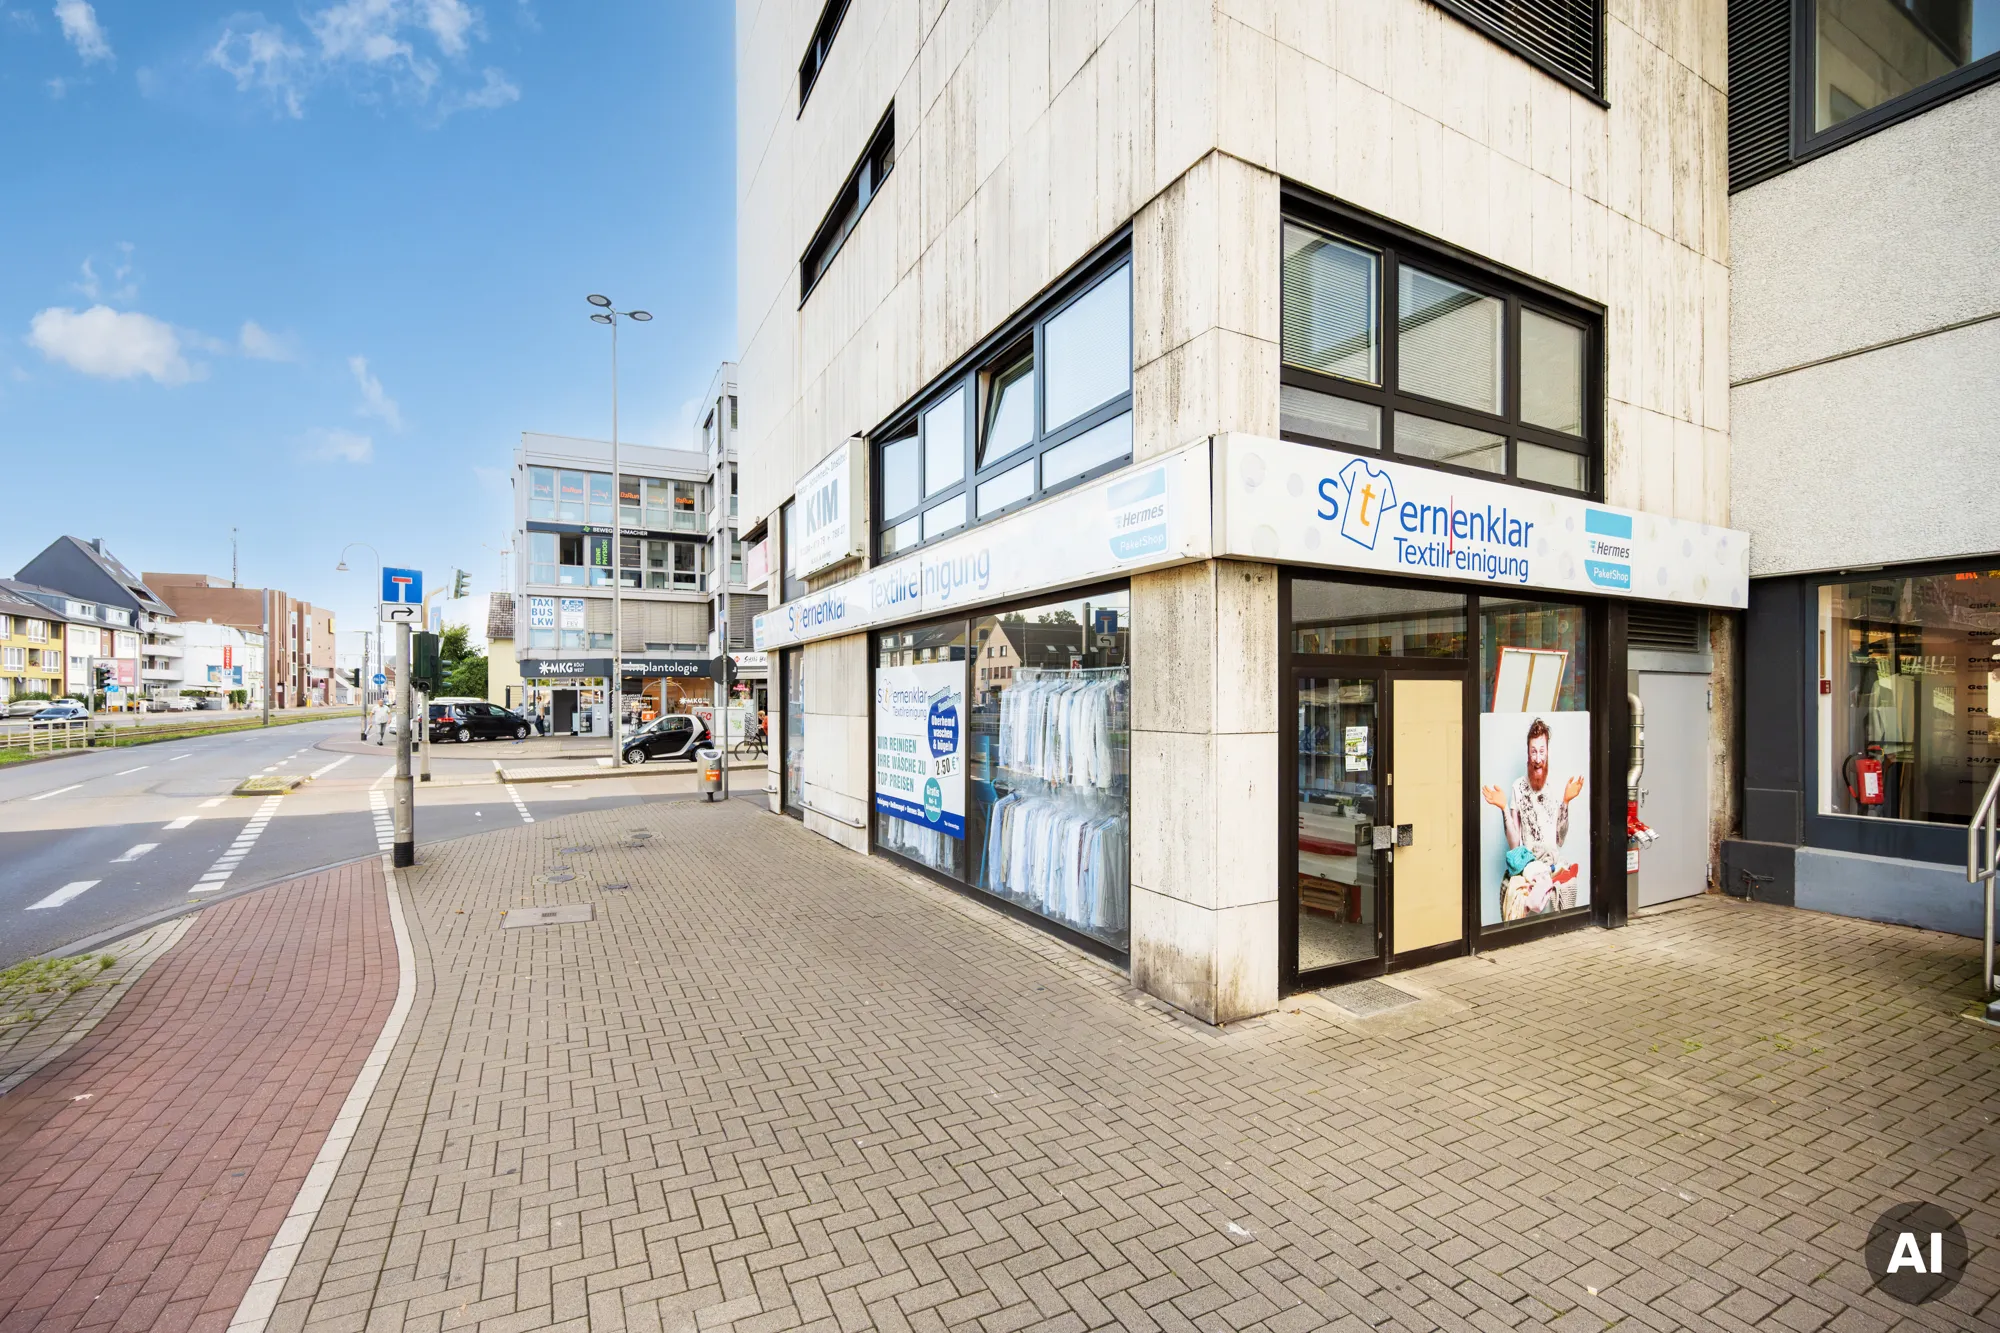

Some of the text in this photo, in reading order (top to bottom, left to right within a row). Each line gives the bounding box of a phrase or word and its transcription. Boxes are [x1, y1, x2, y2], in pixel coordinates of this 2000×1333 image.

[620, 491, 640, 499] DaRun
[806, 478, 839, 538] KIM
[1122, 504, 1164, 528] Hermes
[1317, 476, 1534, 548] Sternenklar
[1120, 533, 1164, 553] PaketShop
[1597, 540, 1630, 559] Hermes
[1393, 536, 1529, 583] Textilreinigung
[868, 548, 990, 609] Textilreinigung
[1593, 566, 1629, 584] PaketShop
[531, 598, 553, 607] TAXI
[531, 608, 553, 616] BUS
[531, 617, 553, 626] LKW
[550, 662, 573, 674] MKG
[877, 736, 917, 754] WIR REINIGEN
[877, 752, 926, 775] IHRE WÄSCHE ZU
[877, 771, 914, 792] TOP PREISEN
